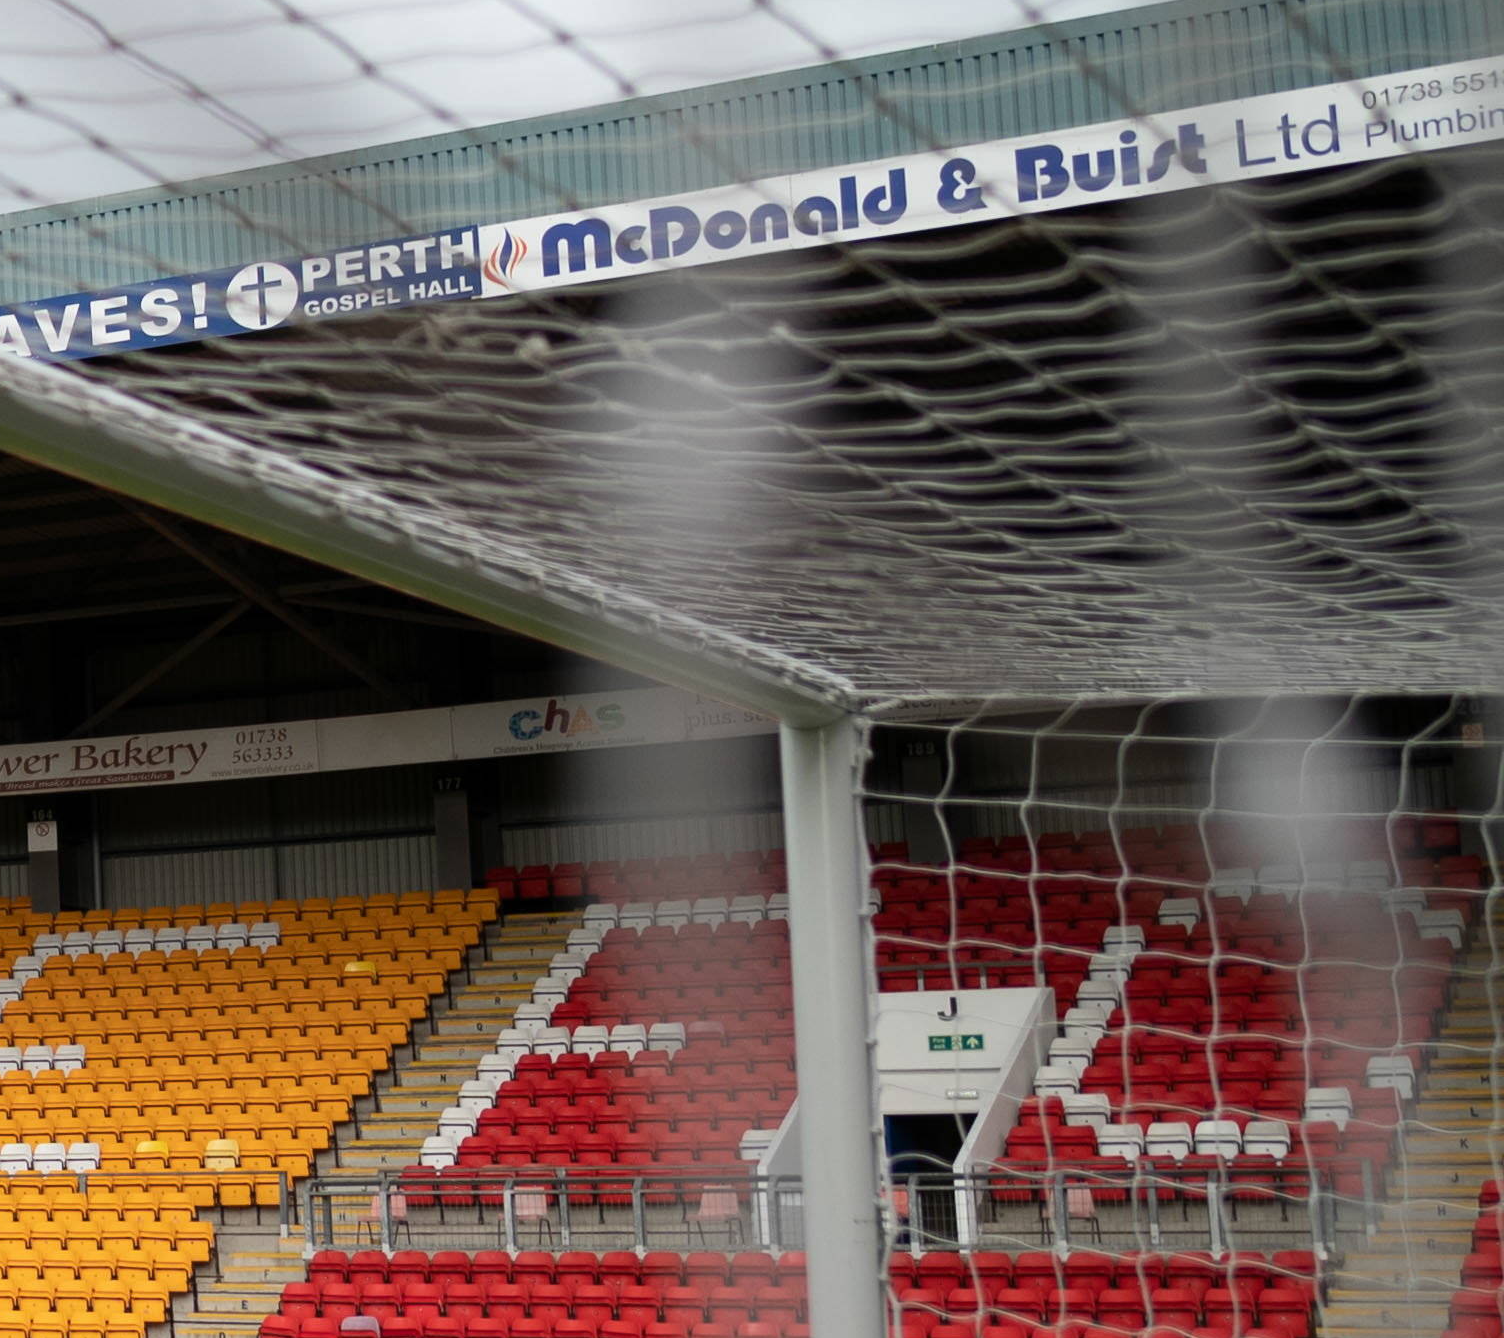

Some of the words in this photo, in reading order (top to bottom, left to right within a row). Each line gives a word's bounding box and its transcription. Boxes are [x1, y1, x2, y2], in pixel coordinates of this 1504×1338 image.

[1362, 80, 1442, 109] 01738
[541, 167, 907, 278] McDonald
[937, 158, 987, 213] &
[1015, 123, 1207, 203] Buist
[1236, 105, 1339, 168] Ltd
[302, 231, 475, 293] PERTH
[304, 289, 400, 317] GOSPEL
[408, 277, 474, 300] HALL
[71, 737, 208, 775] Bakery
[236, 728, 287, 746] 01738
[232, 747, 293, 764] 563333
[437, 776, 462, 790] 177
[937, 997, 957, 1021] J
